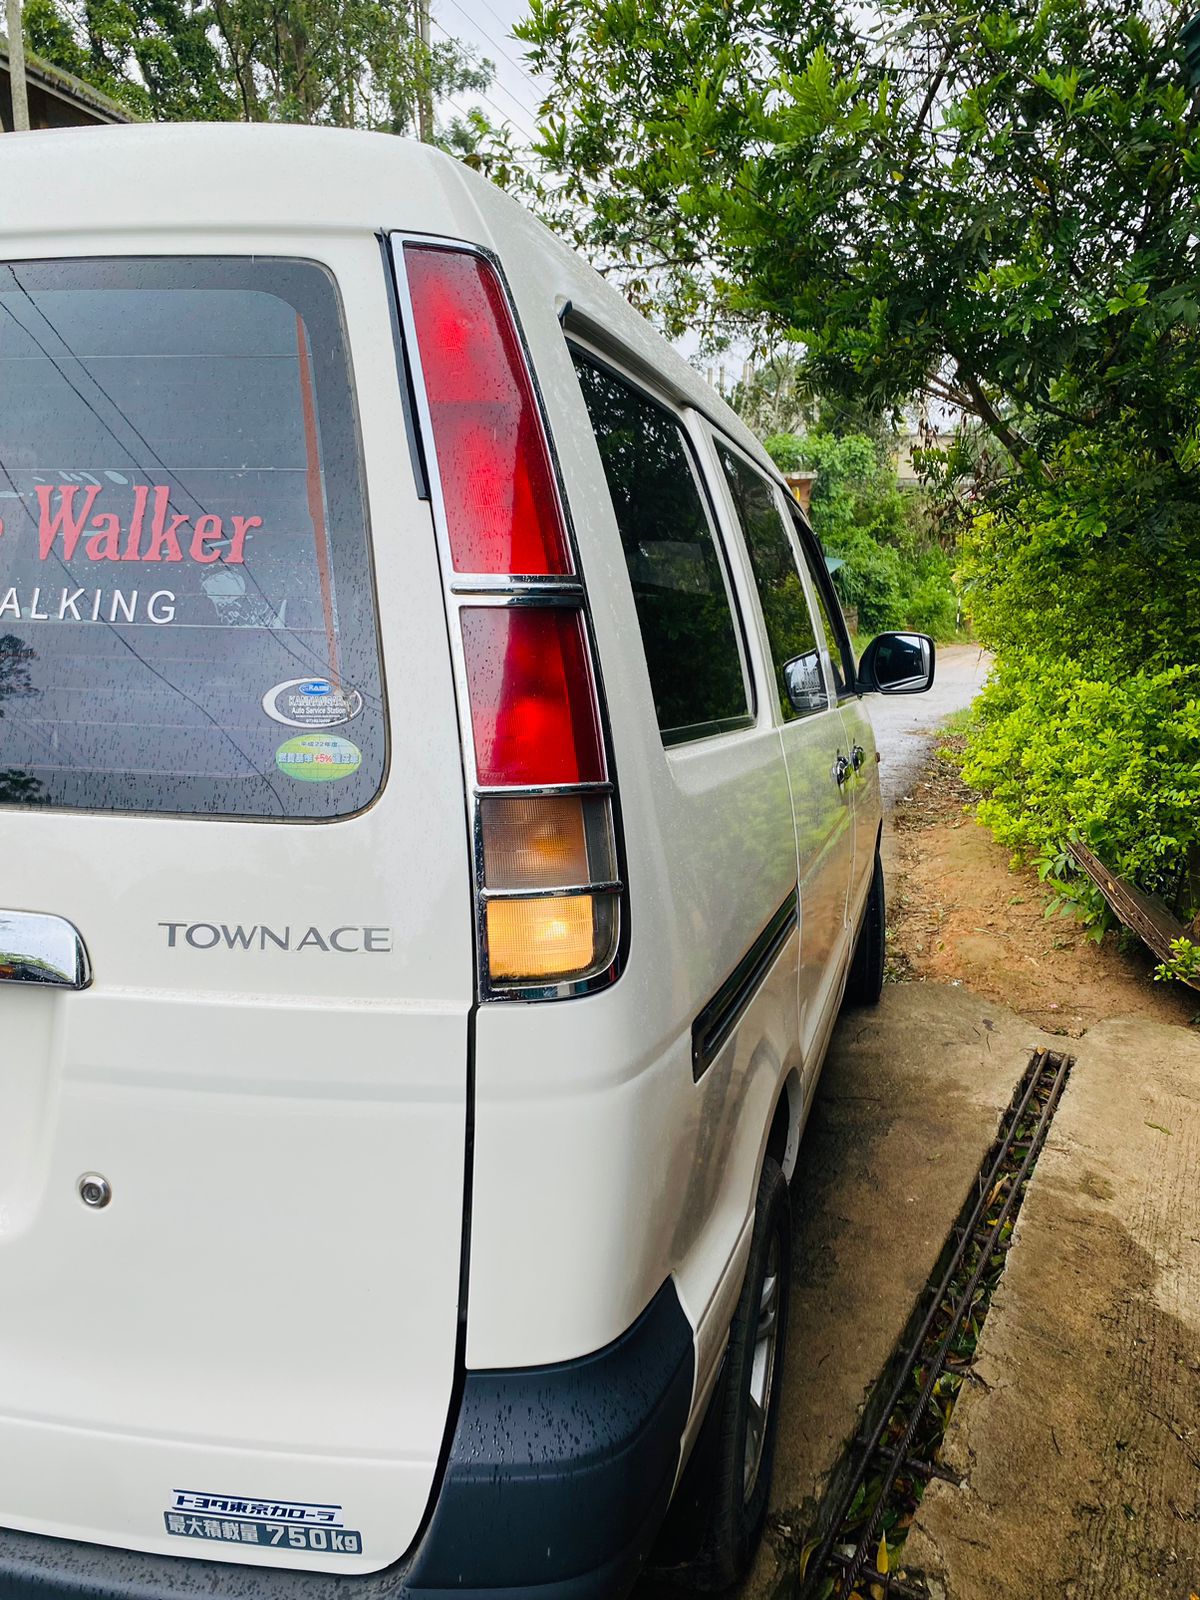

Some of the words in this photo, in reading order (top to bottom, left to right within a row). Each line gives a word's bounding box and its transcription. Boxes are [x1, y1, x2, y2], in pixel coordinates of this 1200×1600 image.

[34, 485, 263, 563] Walker
[291, 707, 305, 715] Auto
[305, 707, 326, 715] Service
[326, 707, 346, 715] Station
[158, 922, 391, 953] TOWNACE
[176, 1494, 336, 1522] トヨタ東京カローラ
